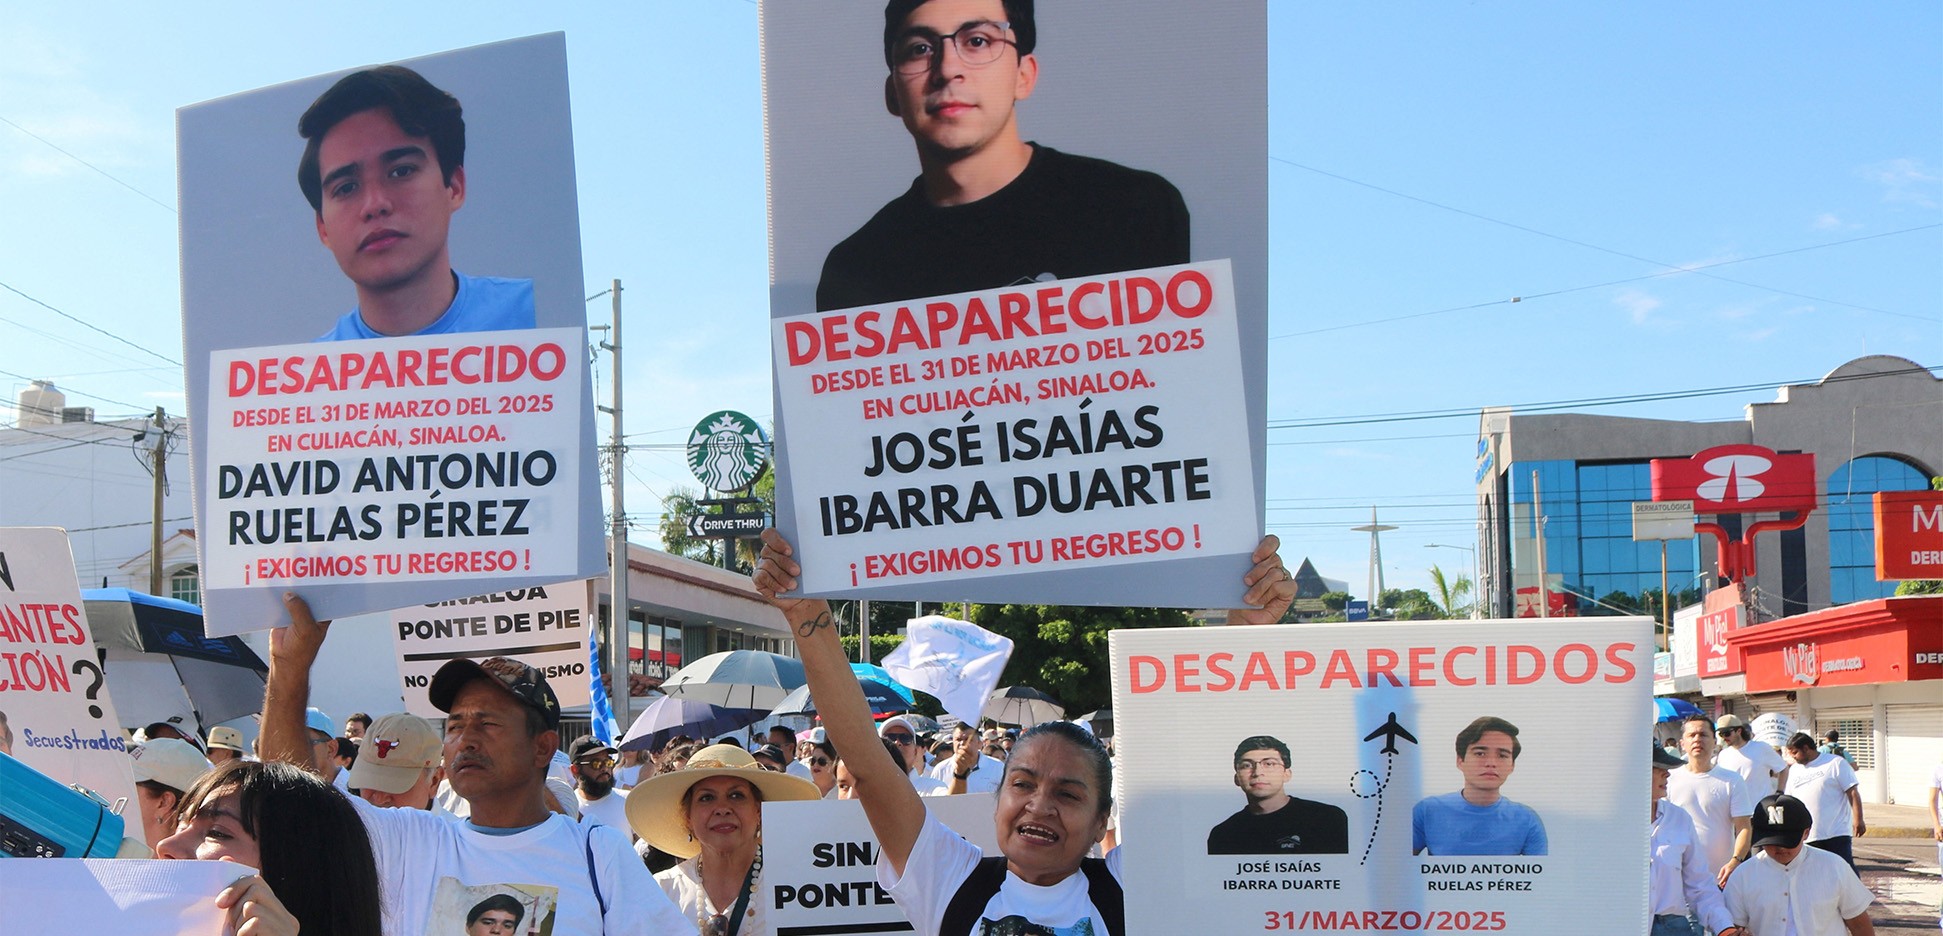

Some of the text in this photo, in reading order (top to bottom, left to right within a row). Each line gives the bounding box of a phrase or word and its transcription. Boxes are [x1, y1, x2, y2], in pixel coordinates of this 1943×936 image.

[784, 270, 1213, 367] DESAPARECIDO
[228, 342, 567, 398] DESAPARECIDO
[811, 328, 1205, 395] DESDE EL 31 DE MARZO DEL 2025
[863, 368, 1156, 419] EN CULIACÁN, SINALOA.
[232, 394, 553, 428] DESDE EL 31 DE MARZO DEL 2025
[268, 424, 506, 453] EN CULIACÁN, SINALOA.
[864, 397, 1164, 477] JOSÉ ISAÍAS
[218, 450, 557, 500] DAVID ANTONIO
[819, 458, 1211, 536] IBARRA DUARTE
[1636, 503, 1692, 512] DERMATOLÓGICA
[229, 489, 530, 546] RUELAS PÉREZ
[704, 518, 763, 530] DRIVE THRU
[257, 553, 367, 579] EXIGIMOS
[373, 552, 402, 575] TU
[408, 550, 517, 574] REGRESO
[865, 544, 1002, 579] EXIGIMOS
[1007, 538, 1043, 565] TU
[1051, 526, 1184, 562] REGRESO
[1911, 551, 1943, 565] DER
[398, 609, 581, 641] PONTE DE PIE
[1128, 642, 1637, 695] DESAPARECIDOS
[1783, 646, 1797, 676] My
[1797, 642, 1816, 676] Piel
[404, 675, 429, 688] NO
[24, 728, 126, 752] Secuestrados
[1767, 806, 1784, 824] N
[1236, 860, 1321, 875] JOSÉ ISAÍAS
[1421, 864, 1543, 875] DAVID ANTONIO
[774, 882, 895, 910] PONTE
[1223, 879, 1341, 890] IBARRA DUARTE
[1427, 878, 1532, 891] RUELAS PÉREZ
[1264, 910, 1507, 931] 31/MARZO/2025
